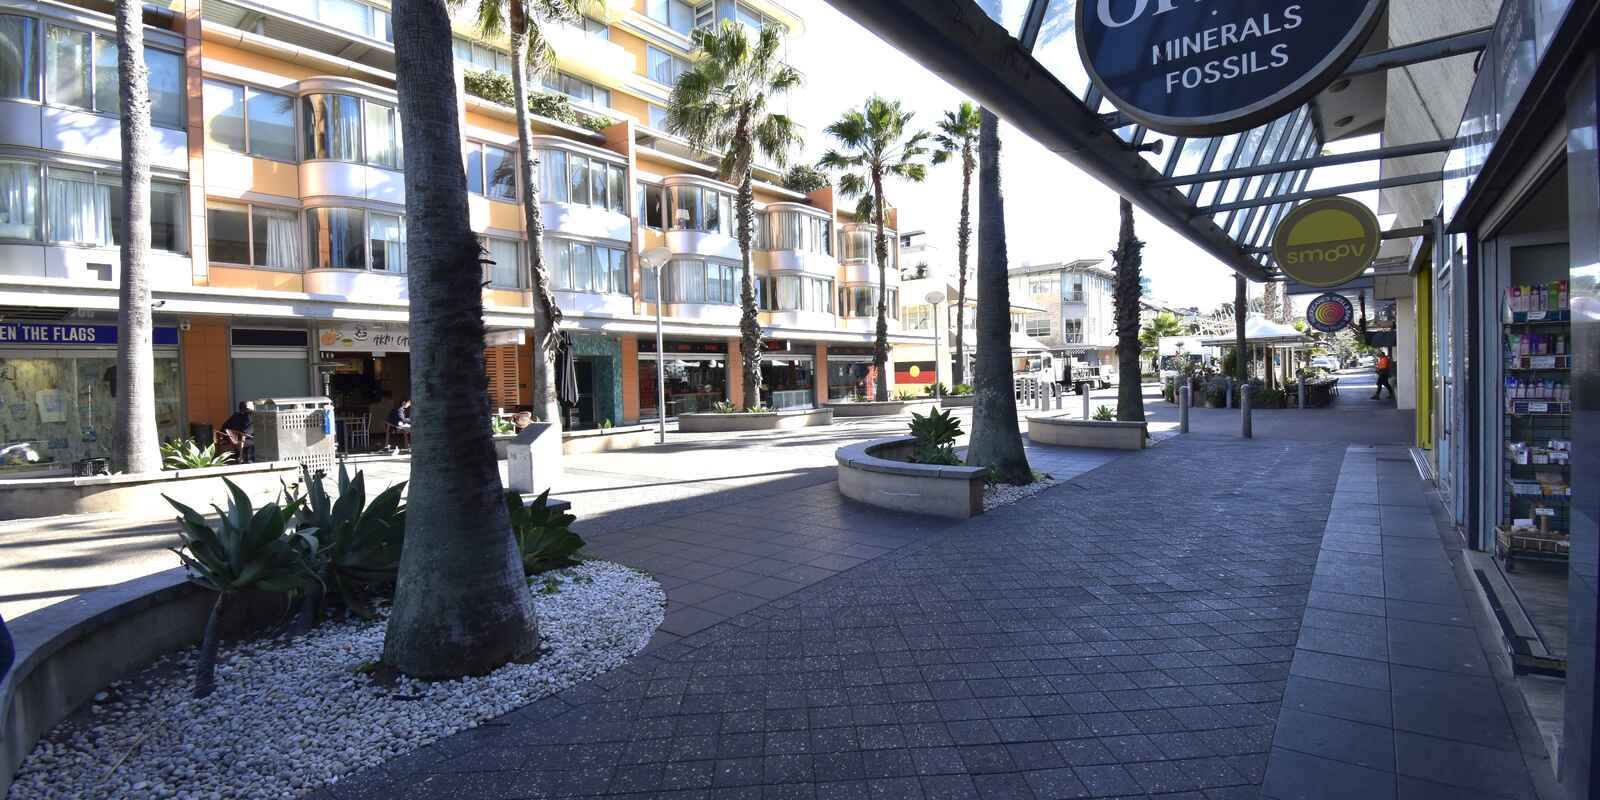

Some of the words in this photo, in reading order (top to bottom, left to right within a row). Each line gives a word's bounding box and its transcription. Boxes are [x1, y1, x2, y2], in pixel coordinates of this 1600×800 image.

[1152, 4, 1303, 65] MINERALS
[1166, 43, 1289, 94] FOSSILS
[1287, 243, 1366, 264] smoov
[22, 326, 49, 341] THE
[53, 327, 96, 341] FLAGS
